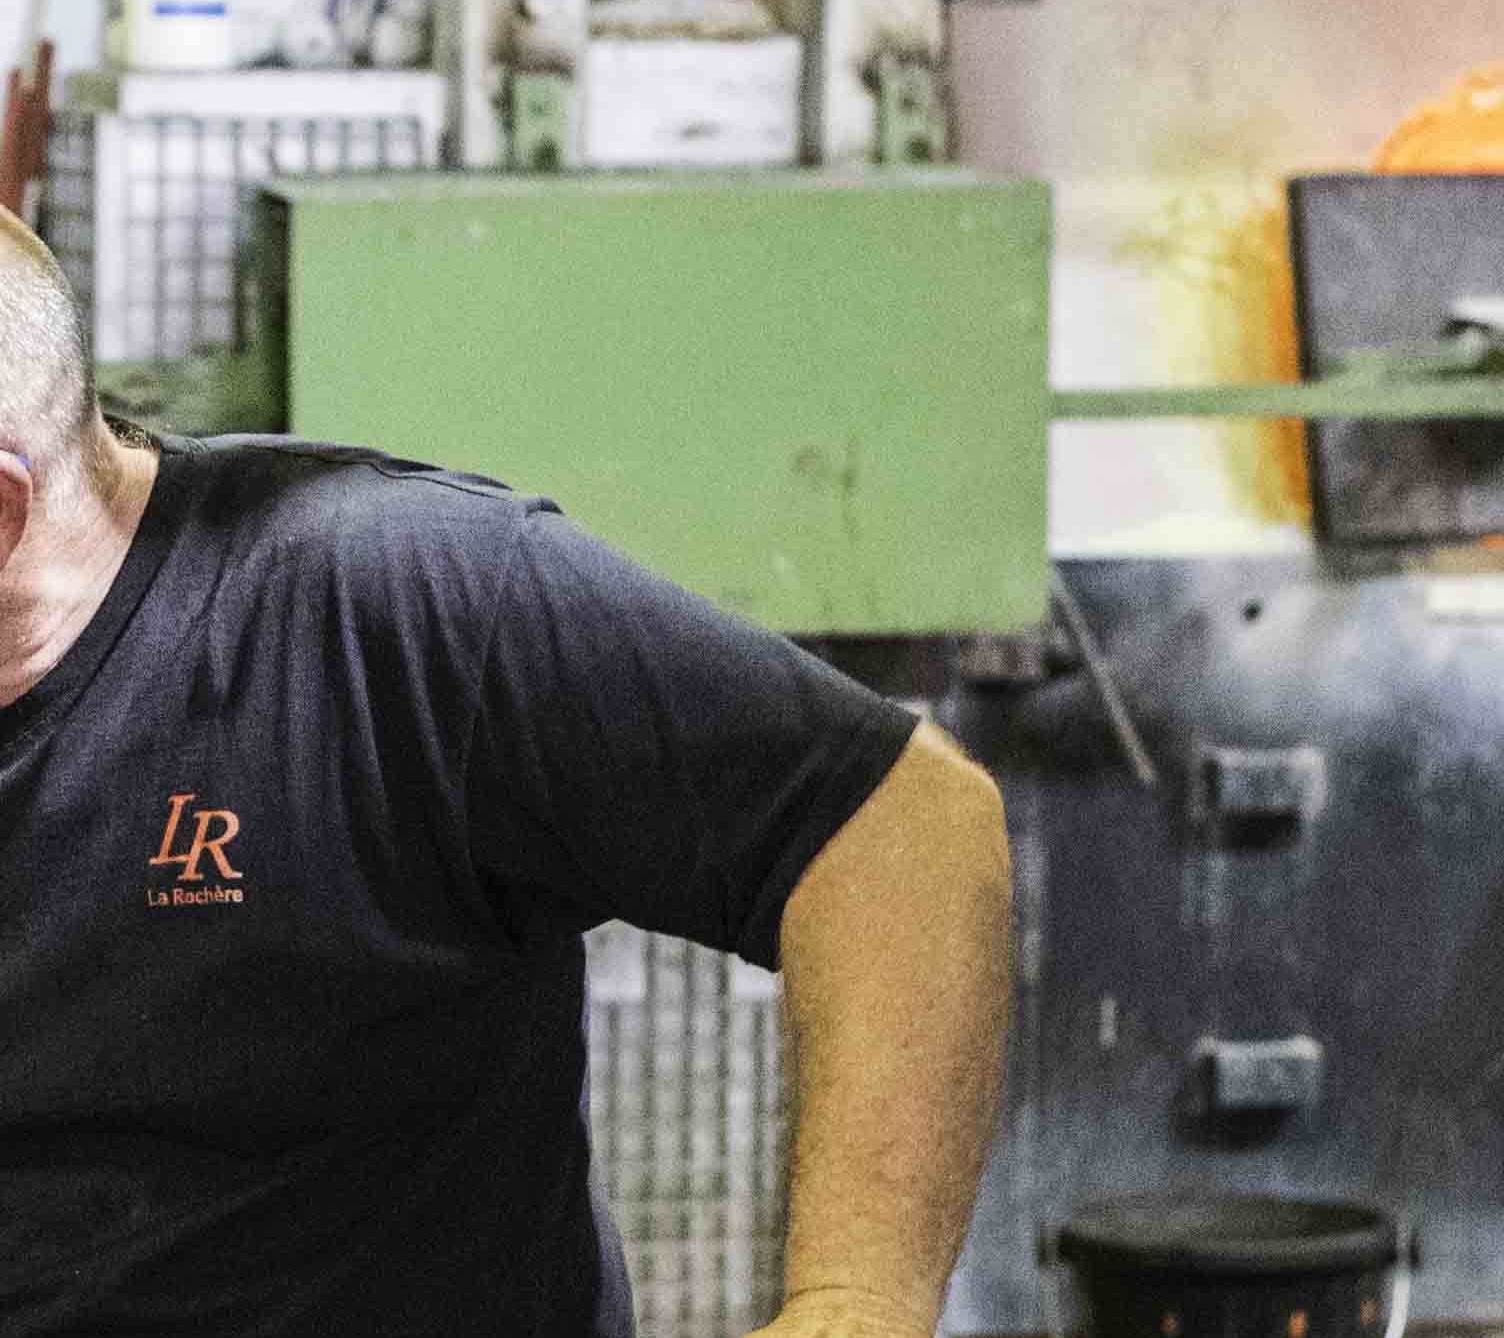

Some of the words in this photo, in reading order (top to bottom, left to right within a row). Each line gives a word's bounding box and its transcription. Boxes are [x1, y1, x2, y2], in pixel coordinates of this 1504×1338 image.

[148, 793, 244, 881] LR
[146, 888, 169, 907] La
[172, 884, 244, 906] Rochère
